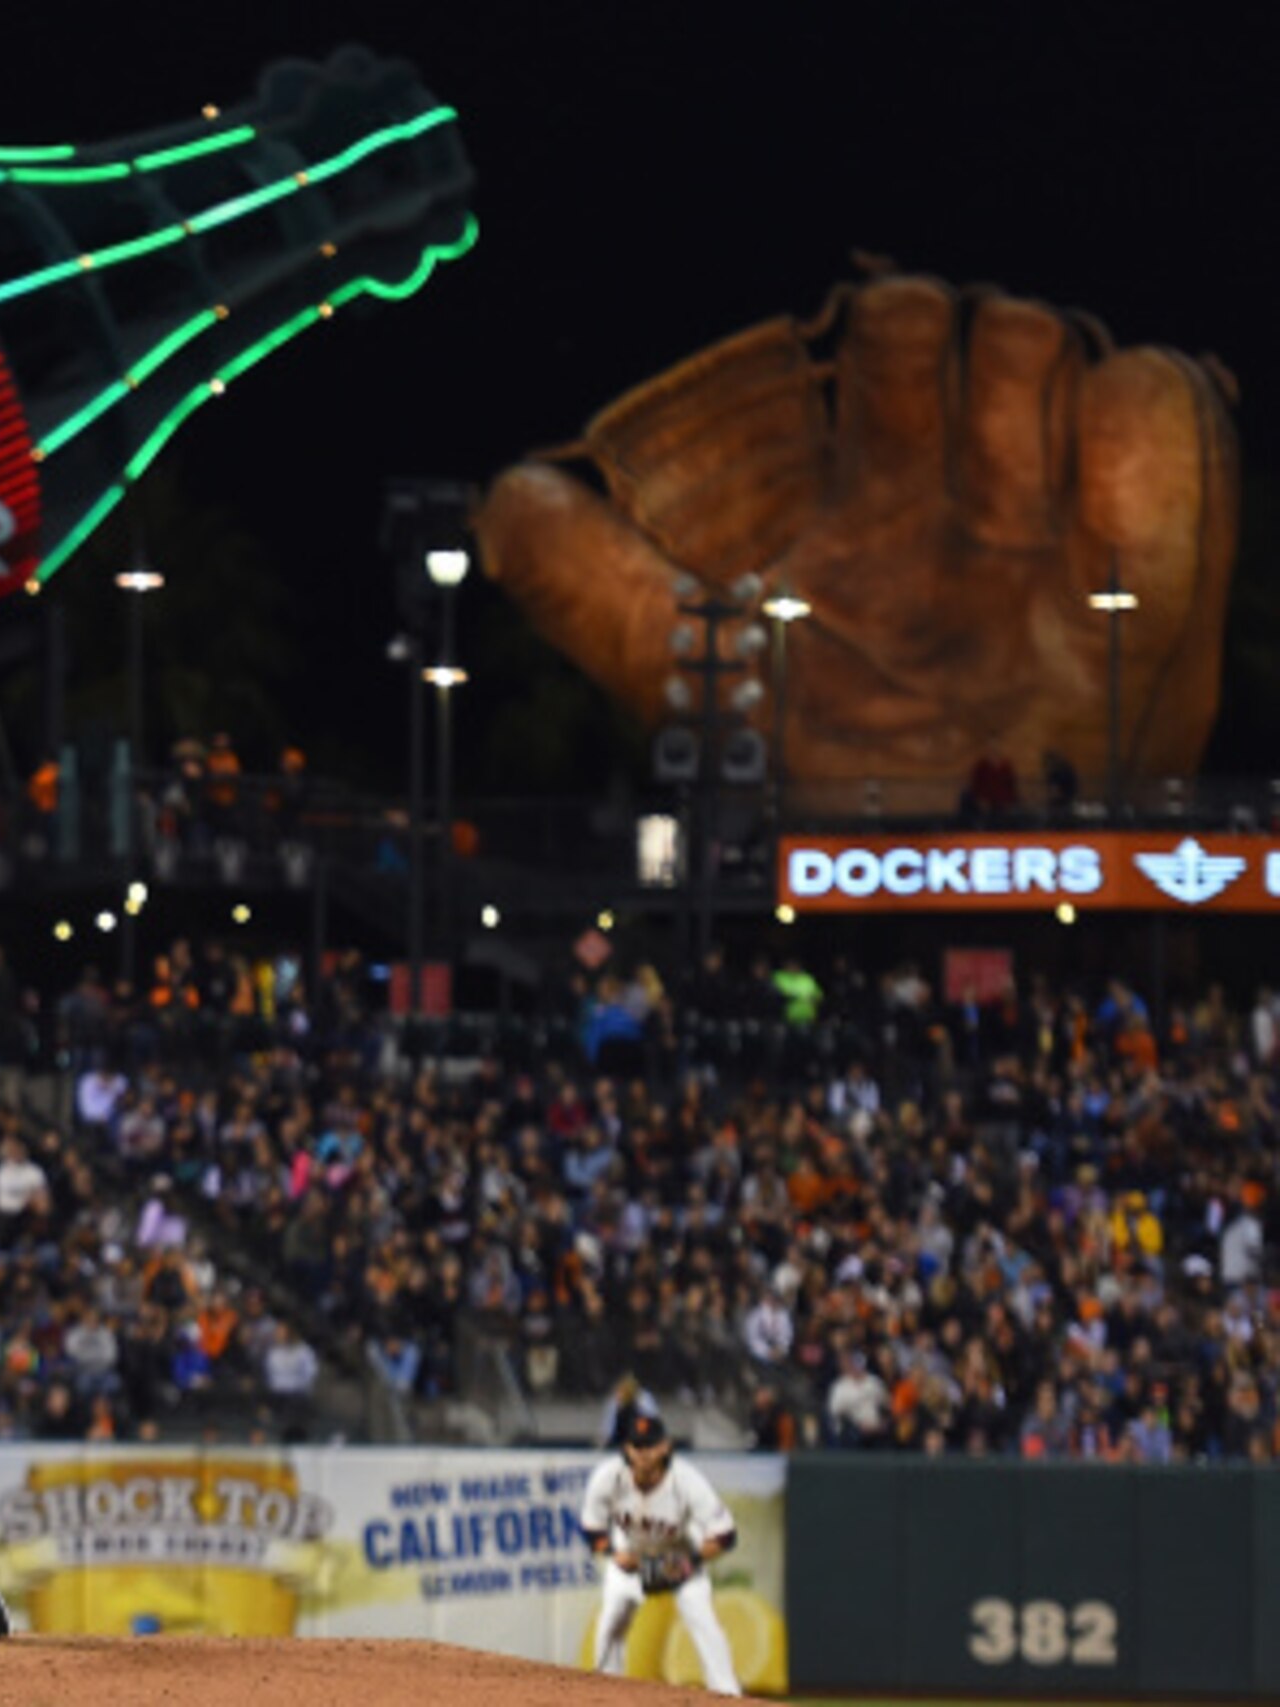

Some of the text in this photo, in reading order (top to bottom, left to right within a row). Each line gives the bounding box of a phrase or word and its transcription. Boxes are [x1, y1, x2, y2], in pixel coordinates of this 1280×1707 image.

[788, 846, 1103, 896] DOCKERS
[217, 1478, 334, 1543] TOP
[968, 1598, 1118, 1665] 382
